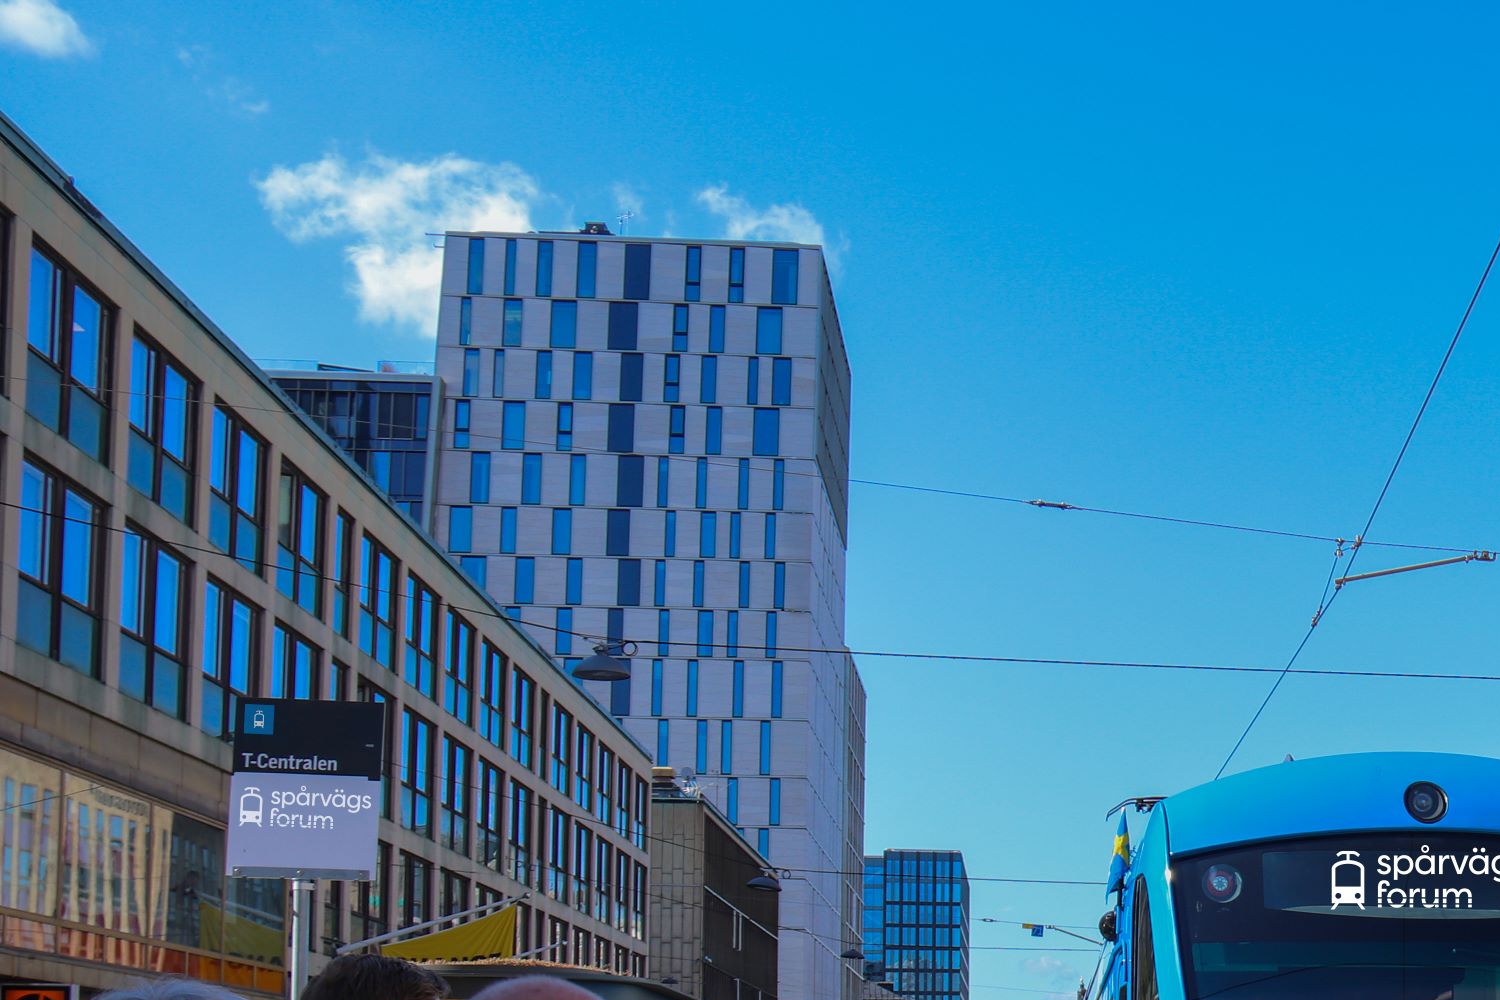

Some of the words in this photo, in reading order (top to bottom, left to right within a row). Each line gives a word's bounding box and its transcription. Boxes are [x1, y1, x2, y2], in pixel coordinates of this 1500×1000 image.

[242, 753, 338, 771] T-Centralen
[270, 785, 372, 814] spårvägs
[269, 808, 334, 830] forum
[1377, 879, 1473, 908] forum
